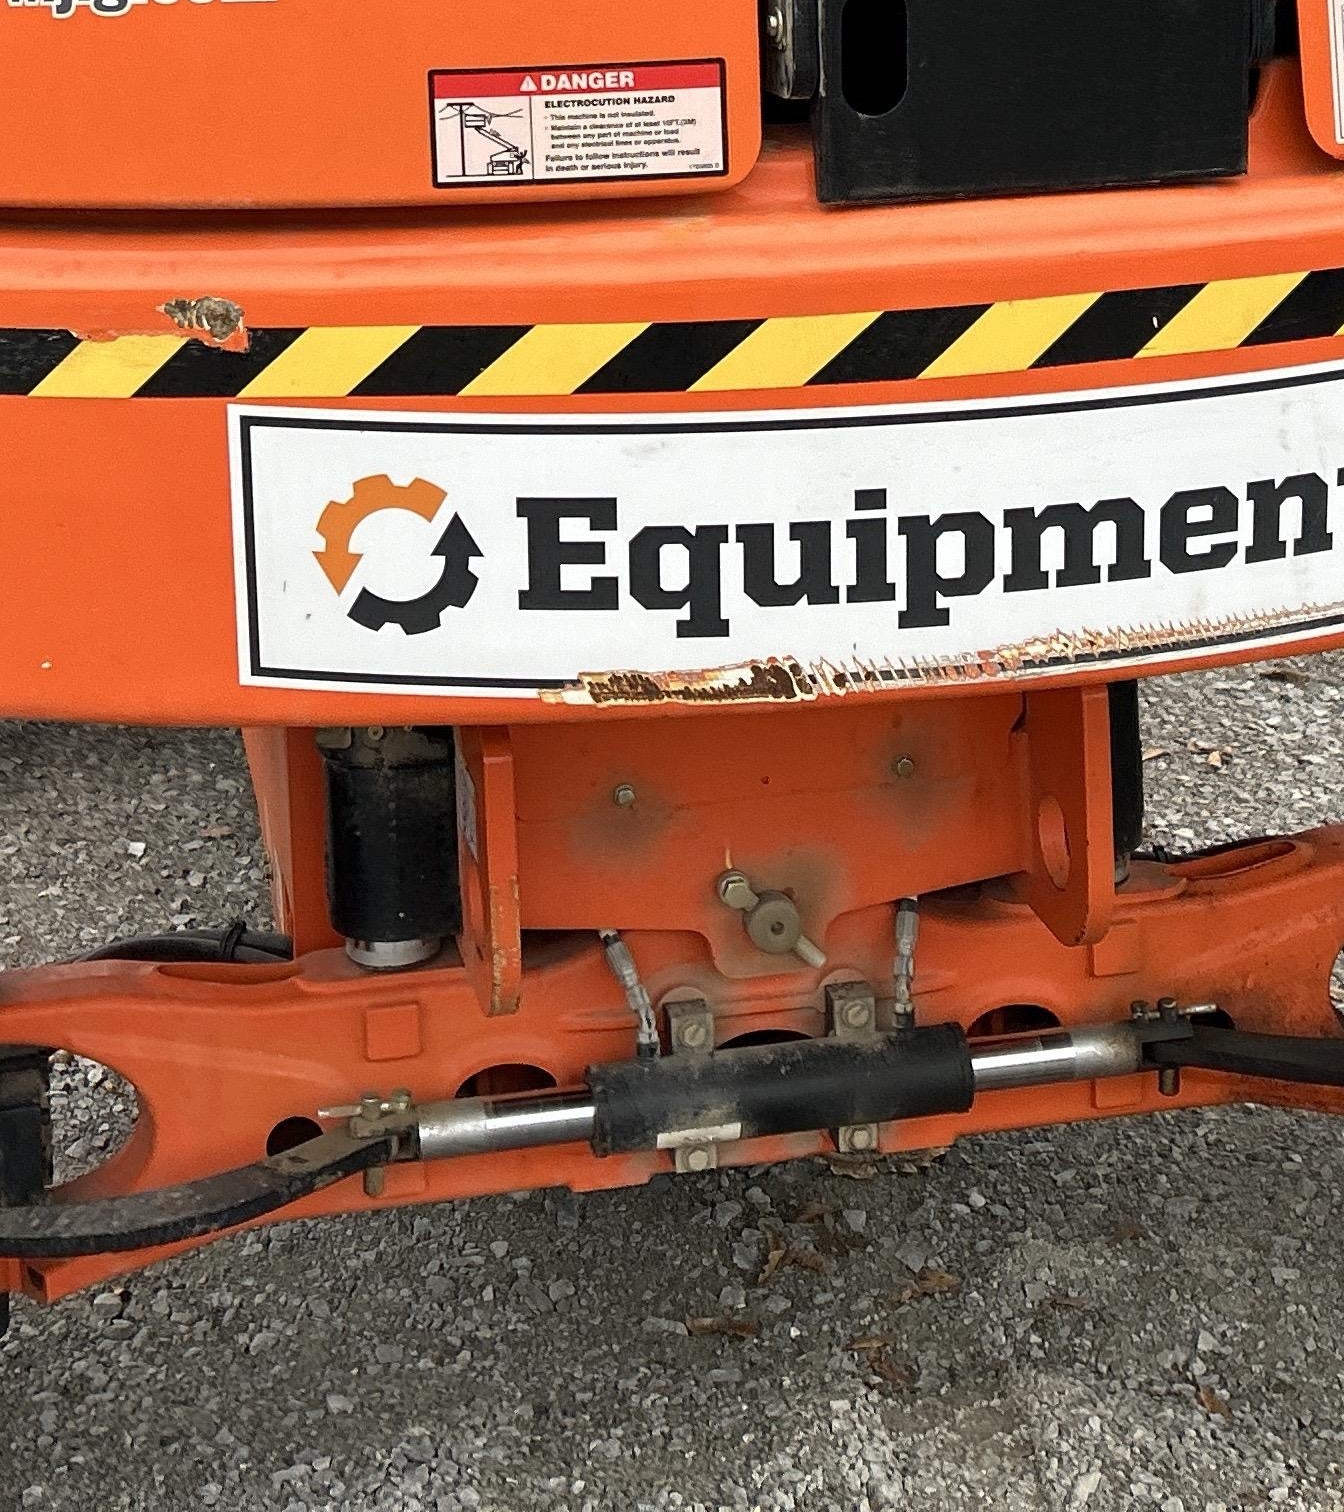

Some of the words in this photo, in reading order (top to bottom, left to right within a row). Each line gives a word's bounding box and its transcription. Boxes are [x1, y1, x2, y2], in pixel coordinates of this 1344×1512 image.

[540, 71, 635, 91] DANGER
[544, 97, 631, 109] ELECTROCUTION
[633, 95, 675, 105] HAZARD
